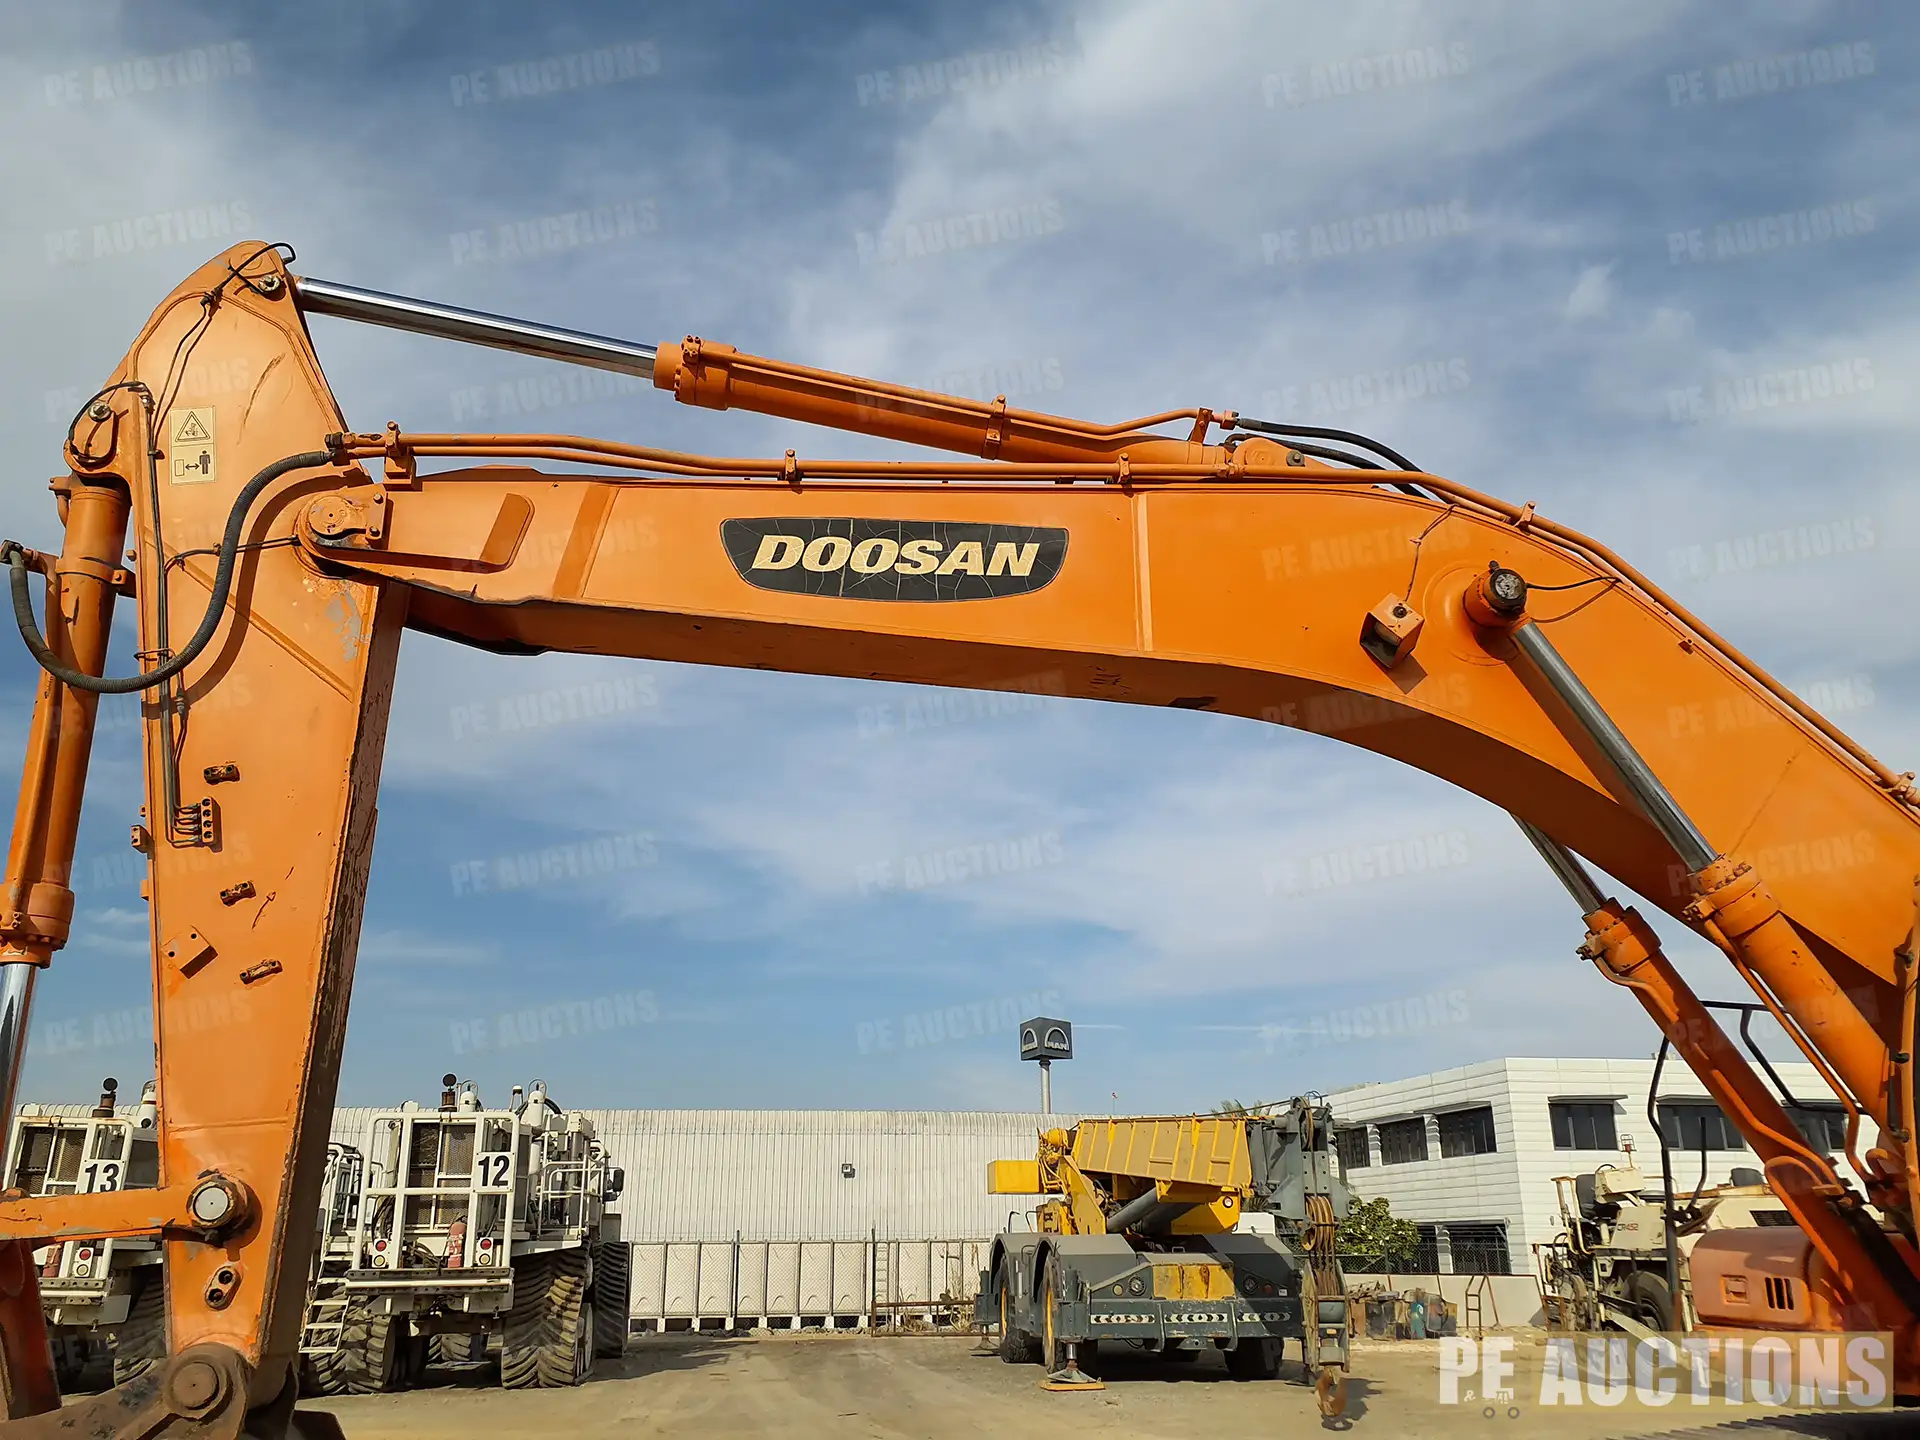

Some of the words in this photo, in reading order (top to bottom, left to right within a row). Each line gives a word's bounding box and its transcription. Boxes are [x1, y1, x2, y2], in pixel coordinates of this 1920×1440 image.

[751, 534, 1040, 577] DOOSAN
[84, 1163, 120, 1194] 13
[478, 1155, 510, 1187] 12
